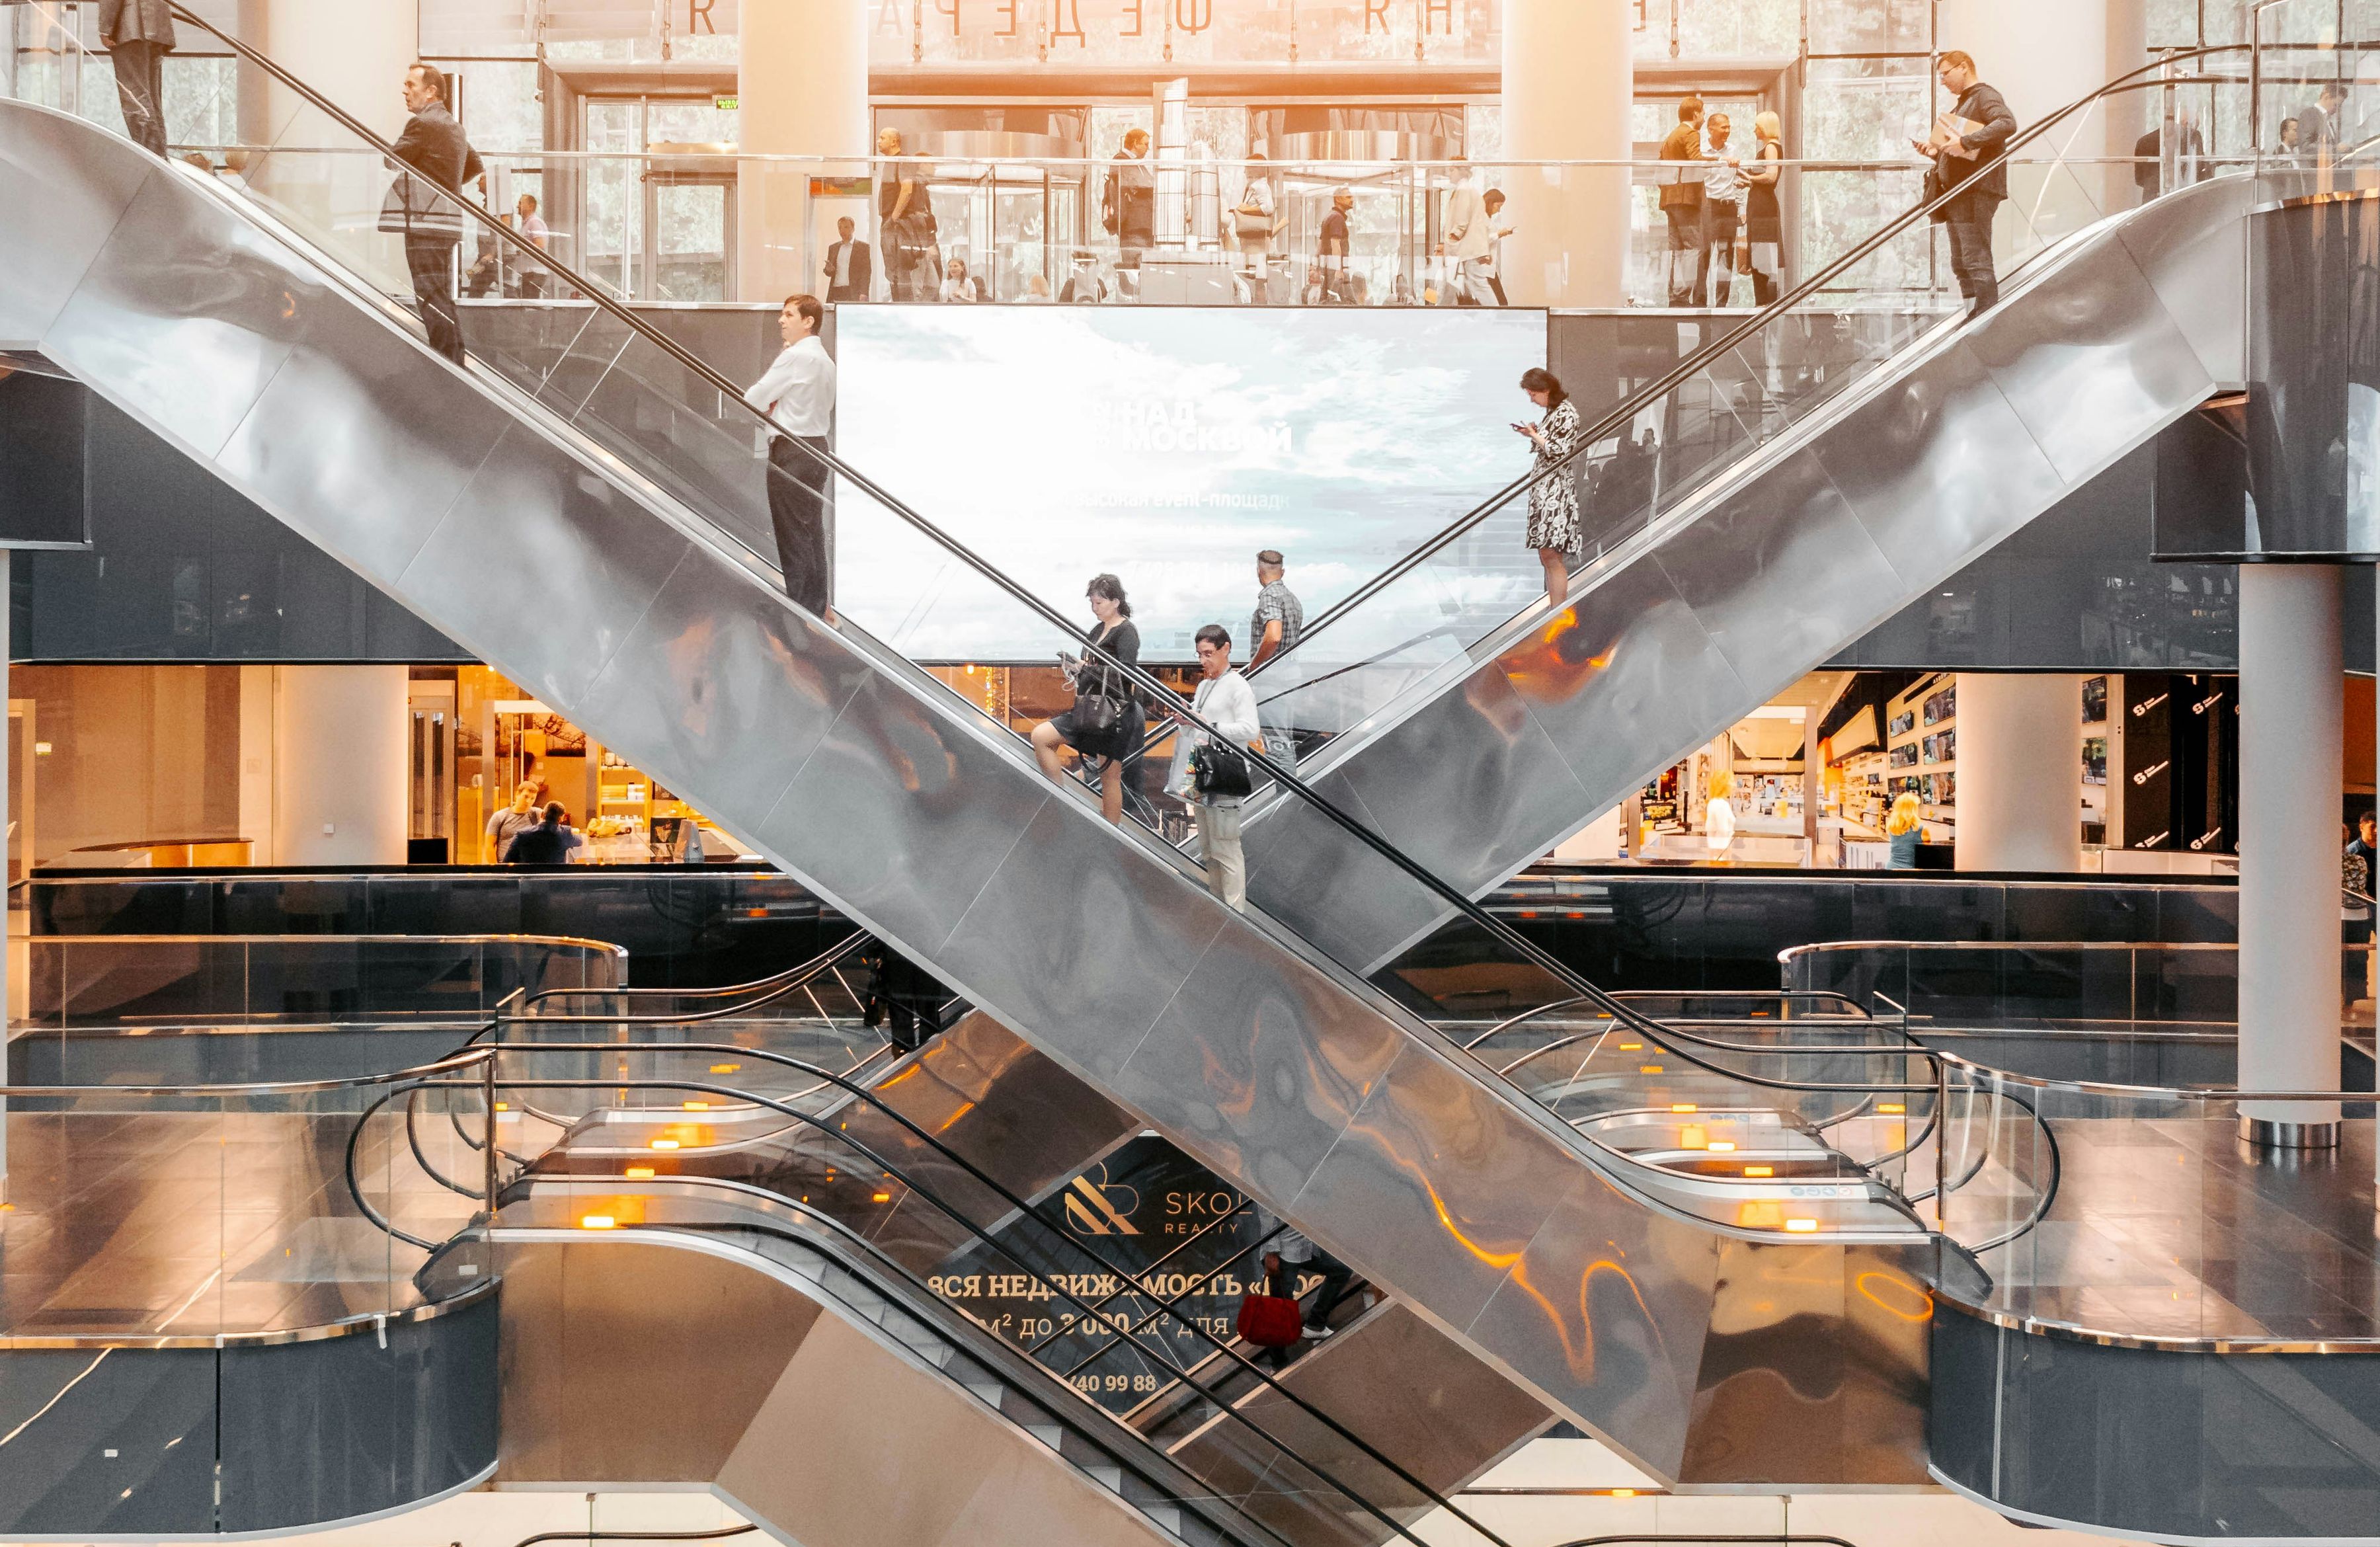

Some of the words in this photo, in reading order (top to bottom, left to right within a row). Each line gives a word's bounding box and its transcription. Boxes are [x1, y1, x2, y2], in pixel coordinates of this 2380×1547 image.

[1123, 401, 1197, 428] НАД
[1123, 421, 1292, 452] МОСКВОЙ
[928, 1275, 982, 1297] ВСЯ
[1105, 1375, 1129, 1392] 99
[1133, 1375, 1156, 1392] 88
